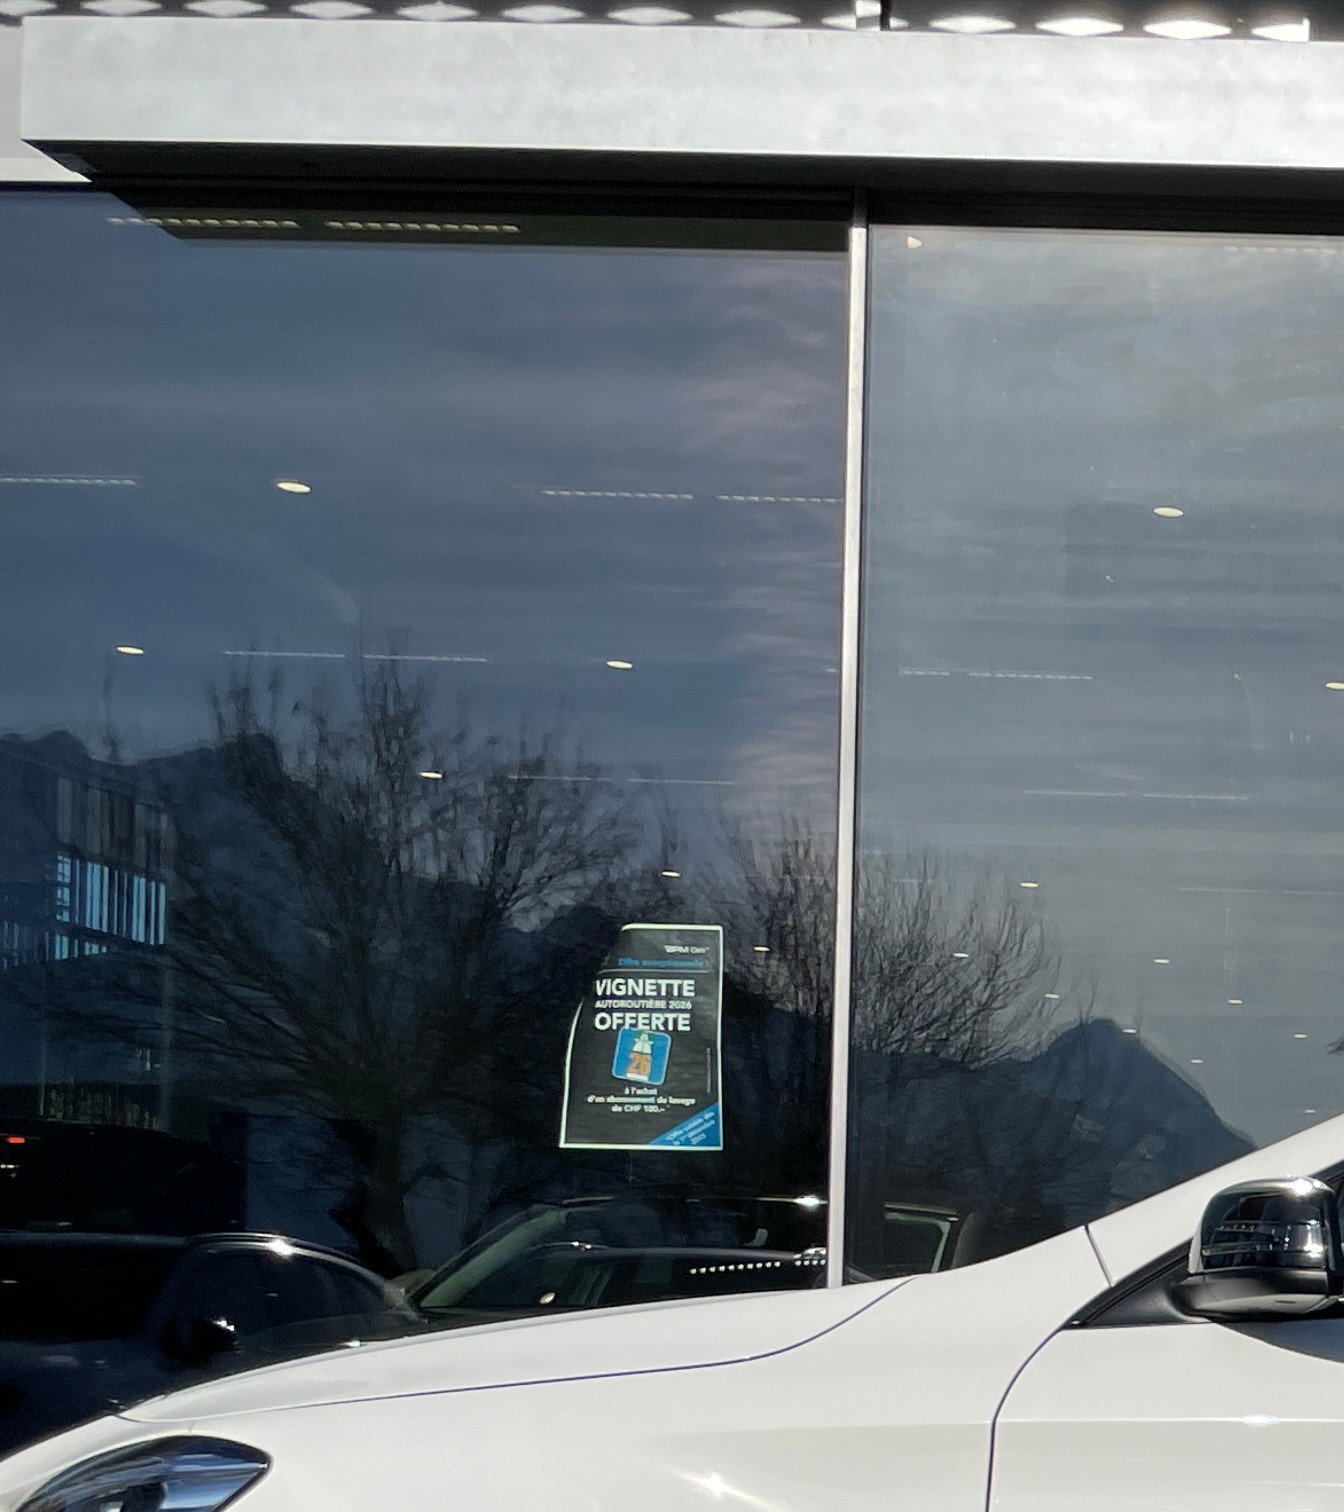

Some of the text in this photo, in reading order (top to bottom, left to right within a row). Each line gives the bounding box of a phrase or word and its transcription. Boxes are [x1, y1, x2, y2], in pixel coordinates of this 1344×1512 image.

[595, 978, 696, 997] VIGNETTE
[668, 1001, 692, 1011] 2026
[594, 1013, 691, 1032] OFFERTE
